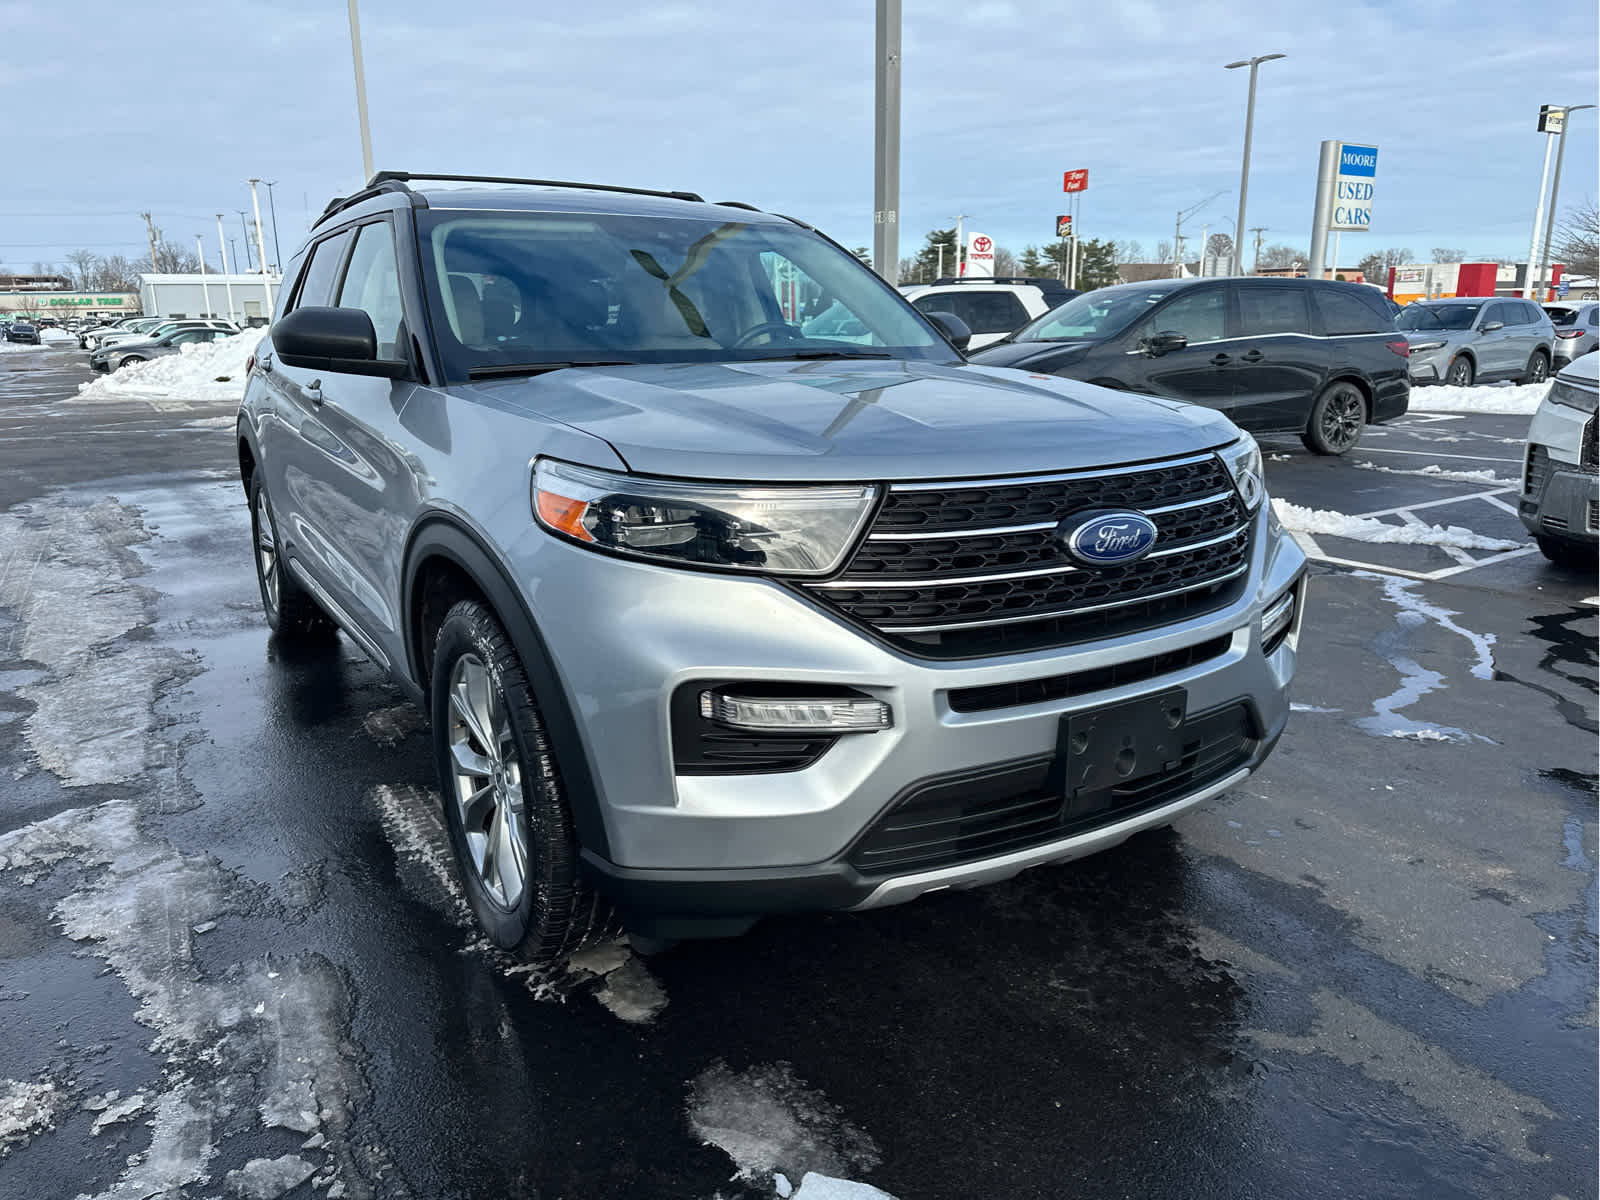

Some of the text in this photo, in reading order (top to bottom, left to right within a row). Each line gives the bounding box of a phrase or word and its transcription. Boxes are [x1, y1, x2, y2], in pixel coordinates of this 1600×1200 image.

[1342, 152, 1376, 167] MOORE
[1337, 181, 1374, 200] USED
[1335, 206, 1371, 225] CARS
[49, 297, 123, 306] DOLLAR TREE
[1095, 523, 1141, 553] Ford
